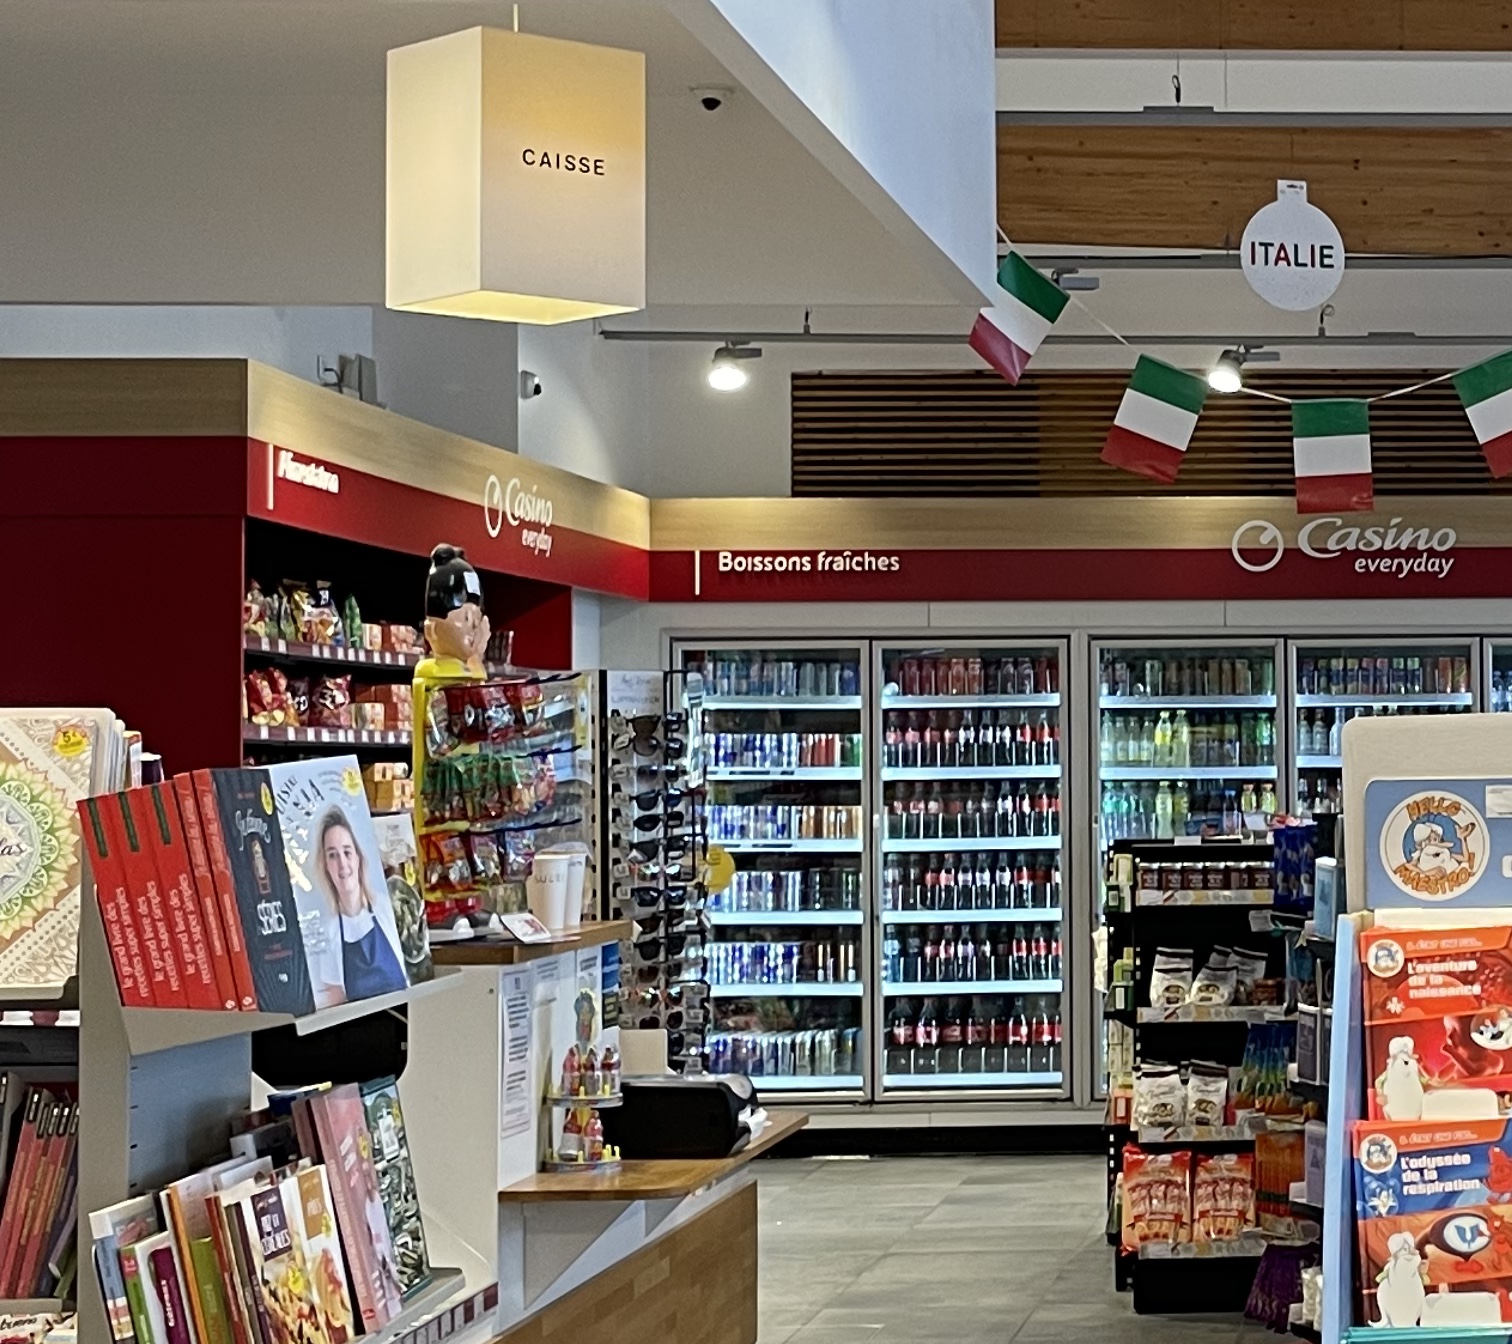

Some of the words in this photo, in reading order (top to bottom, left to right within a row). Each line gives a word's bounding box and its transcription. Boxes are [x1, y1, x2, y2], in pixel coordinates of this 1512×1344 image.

[522, 149, 605, 175] CAISSE
[1250, 241, 1335, 268] ITALIE
[505, 477, 553, 527] Casino
[1297, 517, 1457, 559] Casino
[718, 551, 811, 572] Boissons
[817, 550, 901, 572] fraîches
[1354, 552, 1455, 578] everyday
[1406, 795, 1462, 822] HELLO
[1408, 960, 1477, 974] L'aventure
[1408, 975, 1425, 987] de
[1429, 973, 1443, 985] la
[1401, 1153, 1471, 1170] L'odyssée
[1402, 1170, 1420, 1183] de
[1423, 1168, 1438, 1181] la
